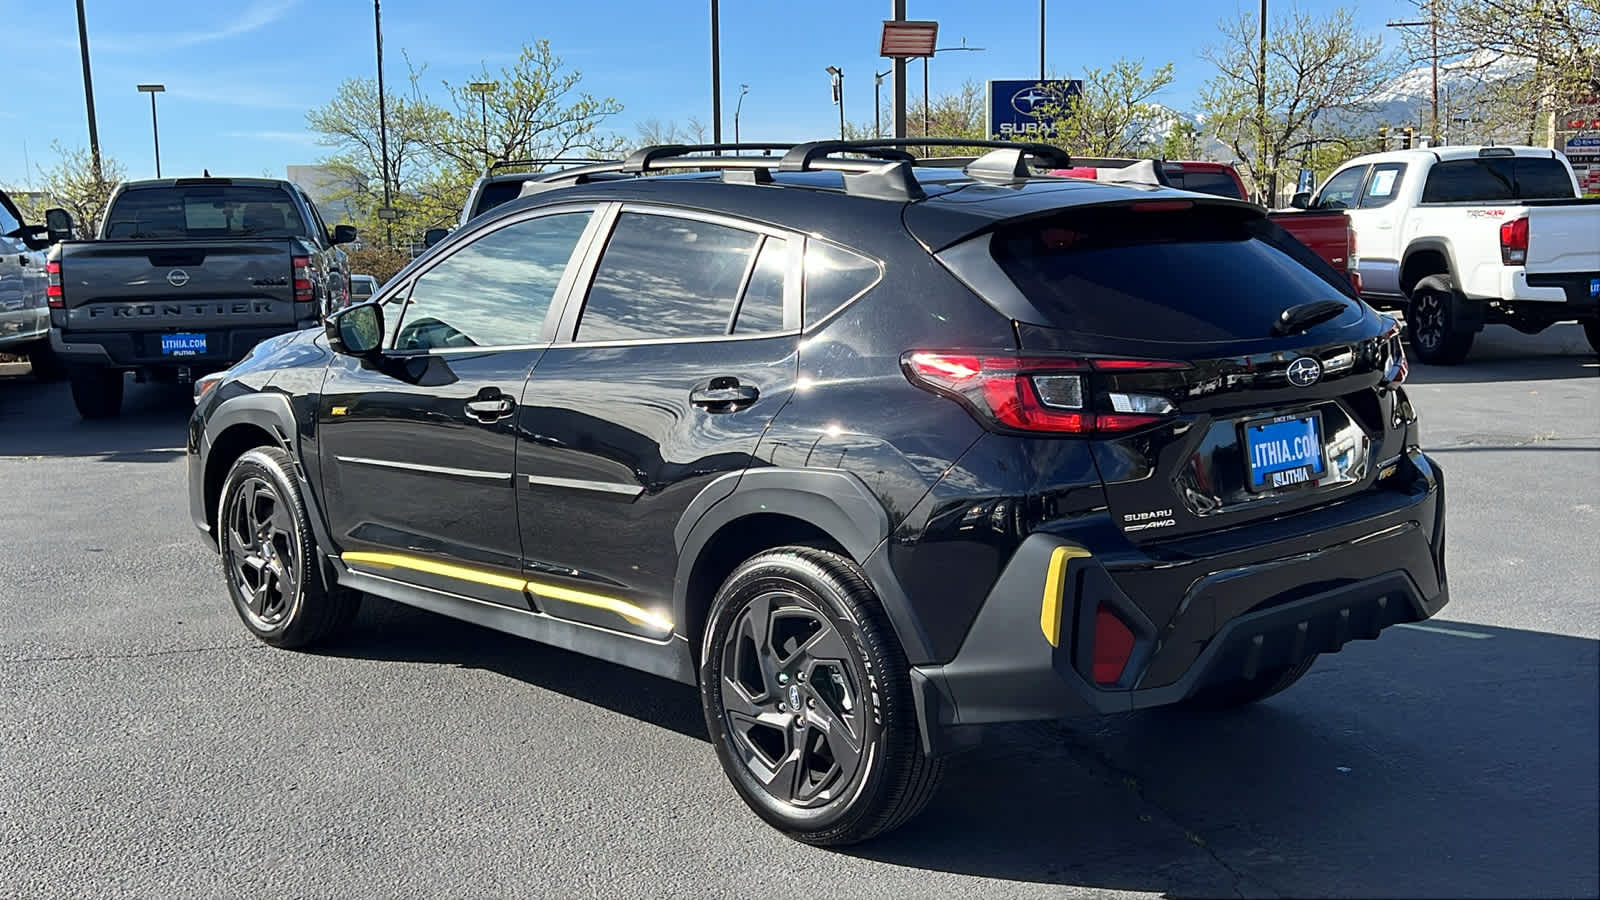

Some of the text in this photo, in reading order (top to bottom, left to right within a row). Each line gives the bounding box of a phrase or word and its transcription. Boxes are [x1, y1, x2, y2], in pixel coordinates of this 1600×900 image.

[1000, 122, 1064, 134] SUBAR
[89, 302, 272, 319] FRONTIER
[162, 339, 206, 349] LITHIA.COM
[1281, 466, 1310, 486] LITHIA
[1124, 509, 1172, 521] SUBARU
[1144, 519, 1176, 529] AWD
